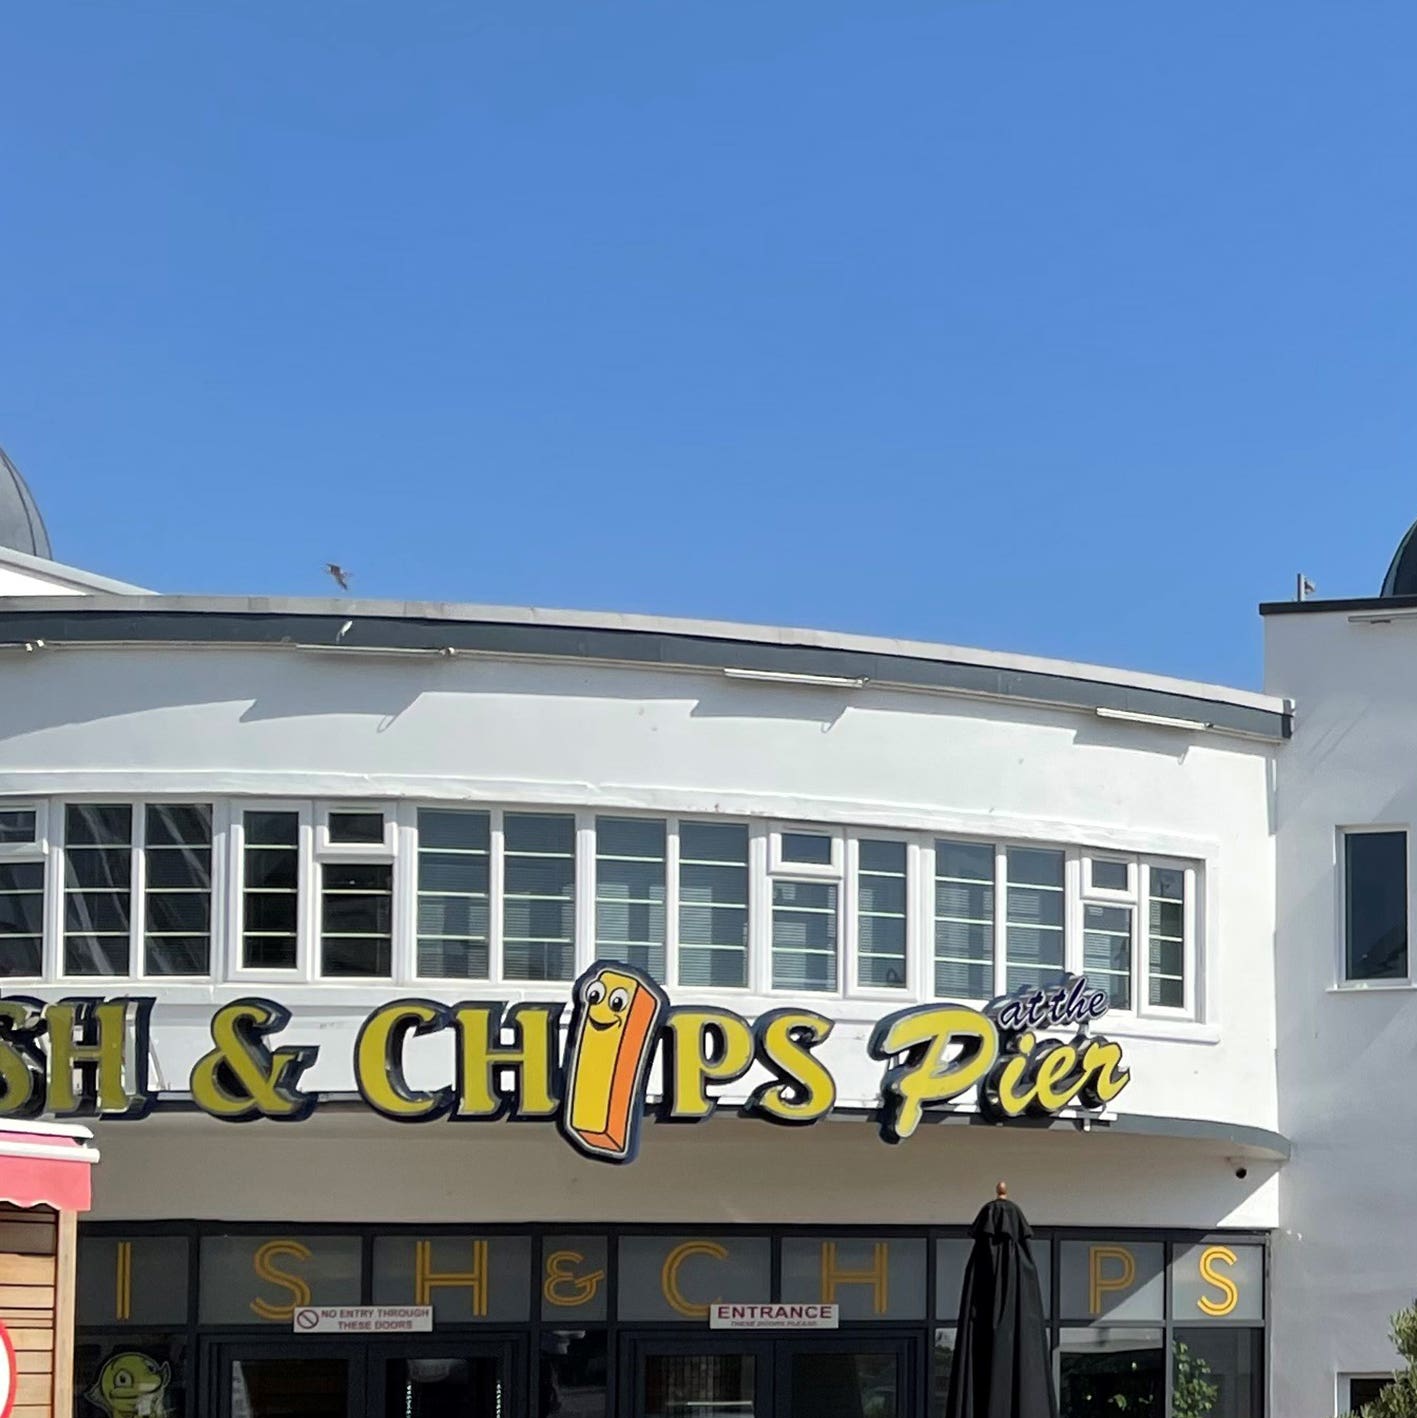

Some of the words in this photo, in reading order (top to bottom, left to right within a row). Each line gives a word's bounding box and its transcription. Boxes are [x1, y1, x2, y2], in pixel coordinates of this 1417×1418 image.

[1000, 992, 1041, 1030] at
[1040, 977, 1109, 1023] the
[190, 998, 318, 1120] &
[880, 1003, 1131, 1138] Pier
[661, 1240, 1239, 1317] CHPS
[320, 1309, 337, 1319] NO
[340, 1309, 373, 1318] ENTRY
[377, 1308, 429, 1318] THROUGH
[338, 1321, 368, 1330] THESE
[375, 1320, 413, 1330] DOORS
[717, 1306, 832, 1319] ENTRANCE
